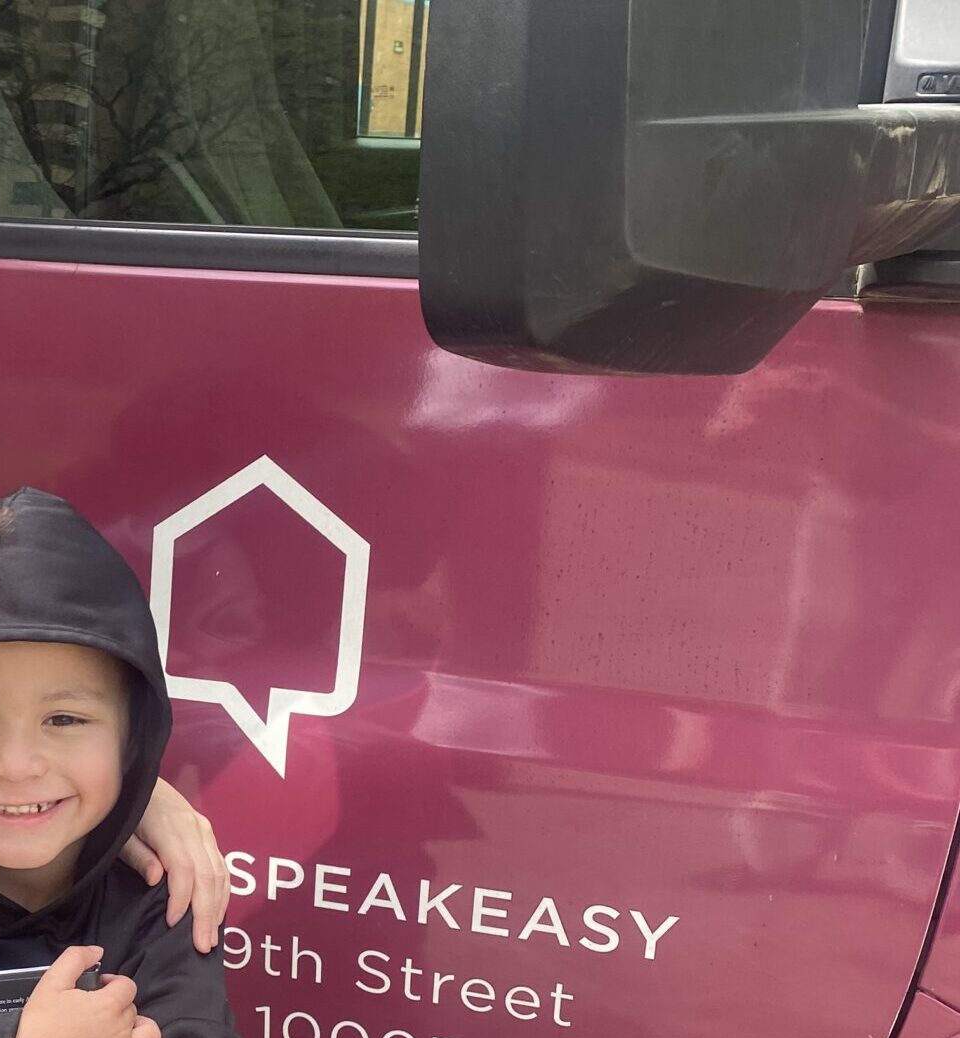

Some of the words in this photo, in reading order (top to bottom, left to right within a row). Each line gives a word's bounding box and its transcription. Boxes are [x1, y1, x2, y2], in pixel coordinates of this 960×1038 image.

[224, 851, 680, 960] SPEAKEASY
[222, 927, 323, 984] 9th
[355, 950, 575, 1027] Street
